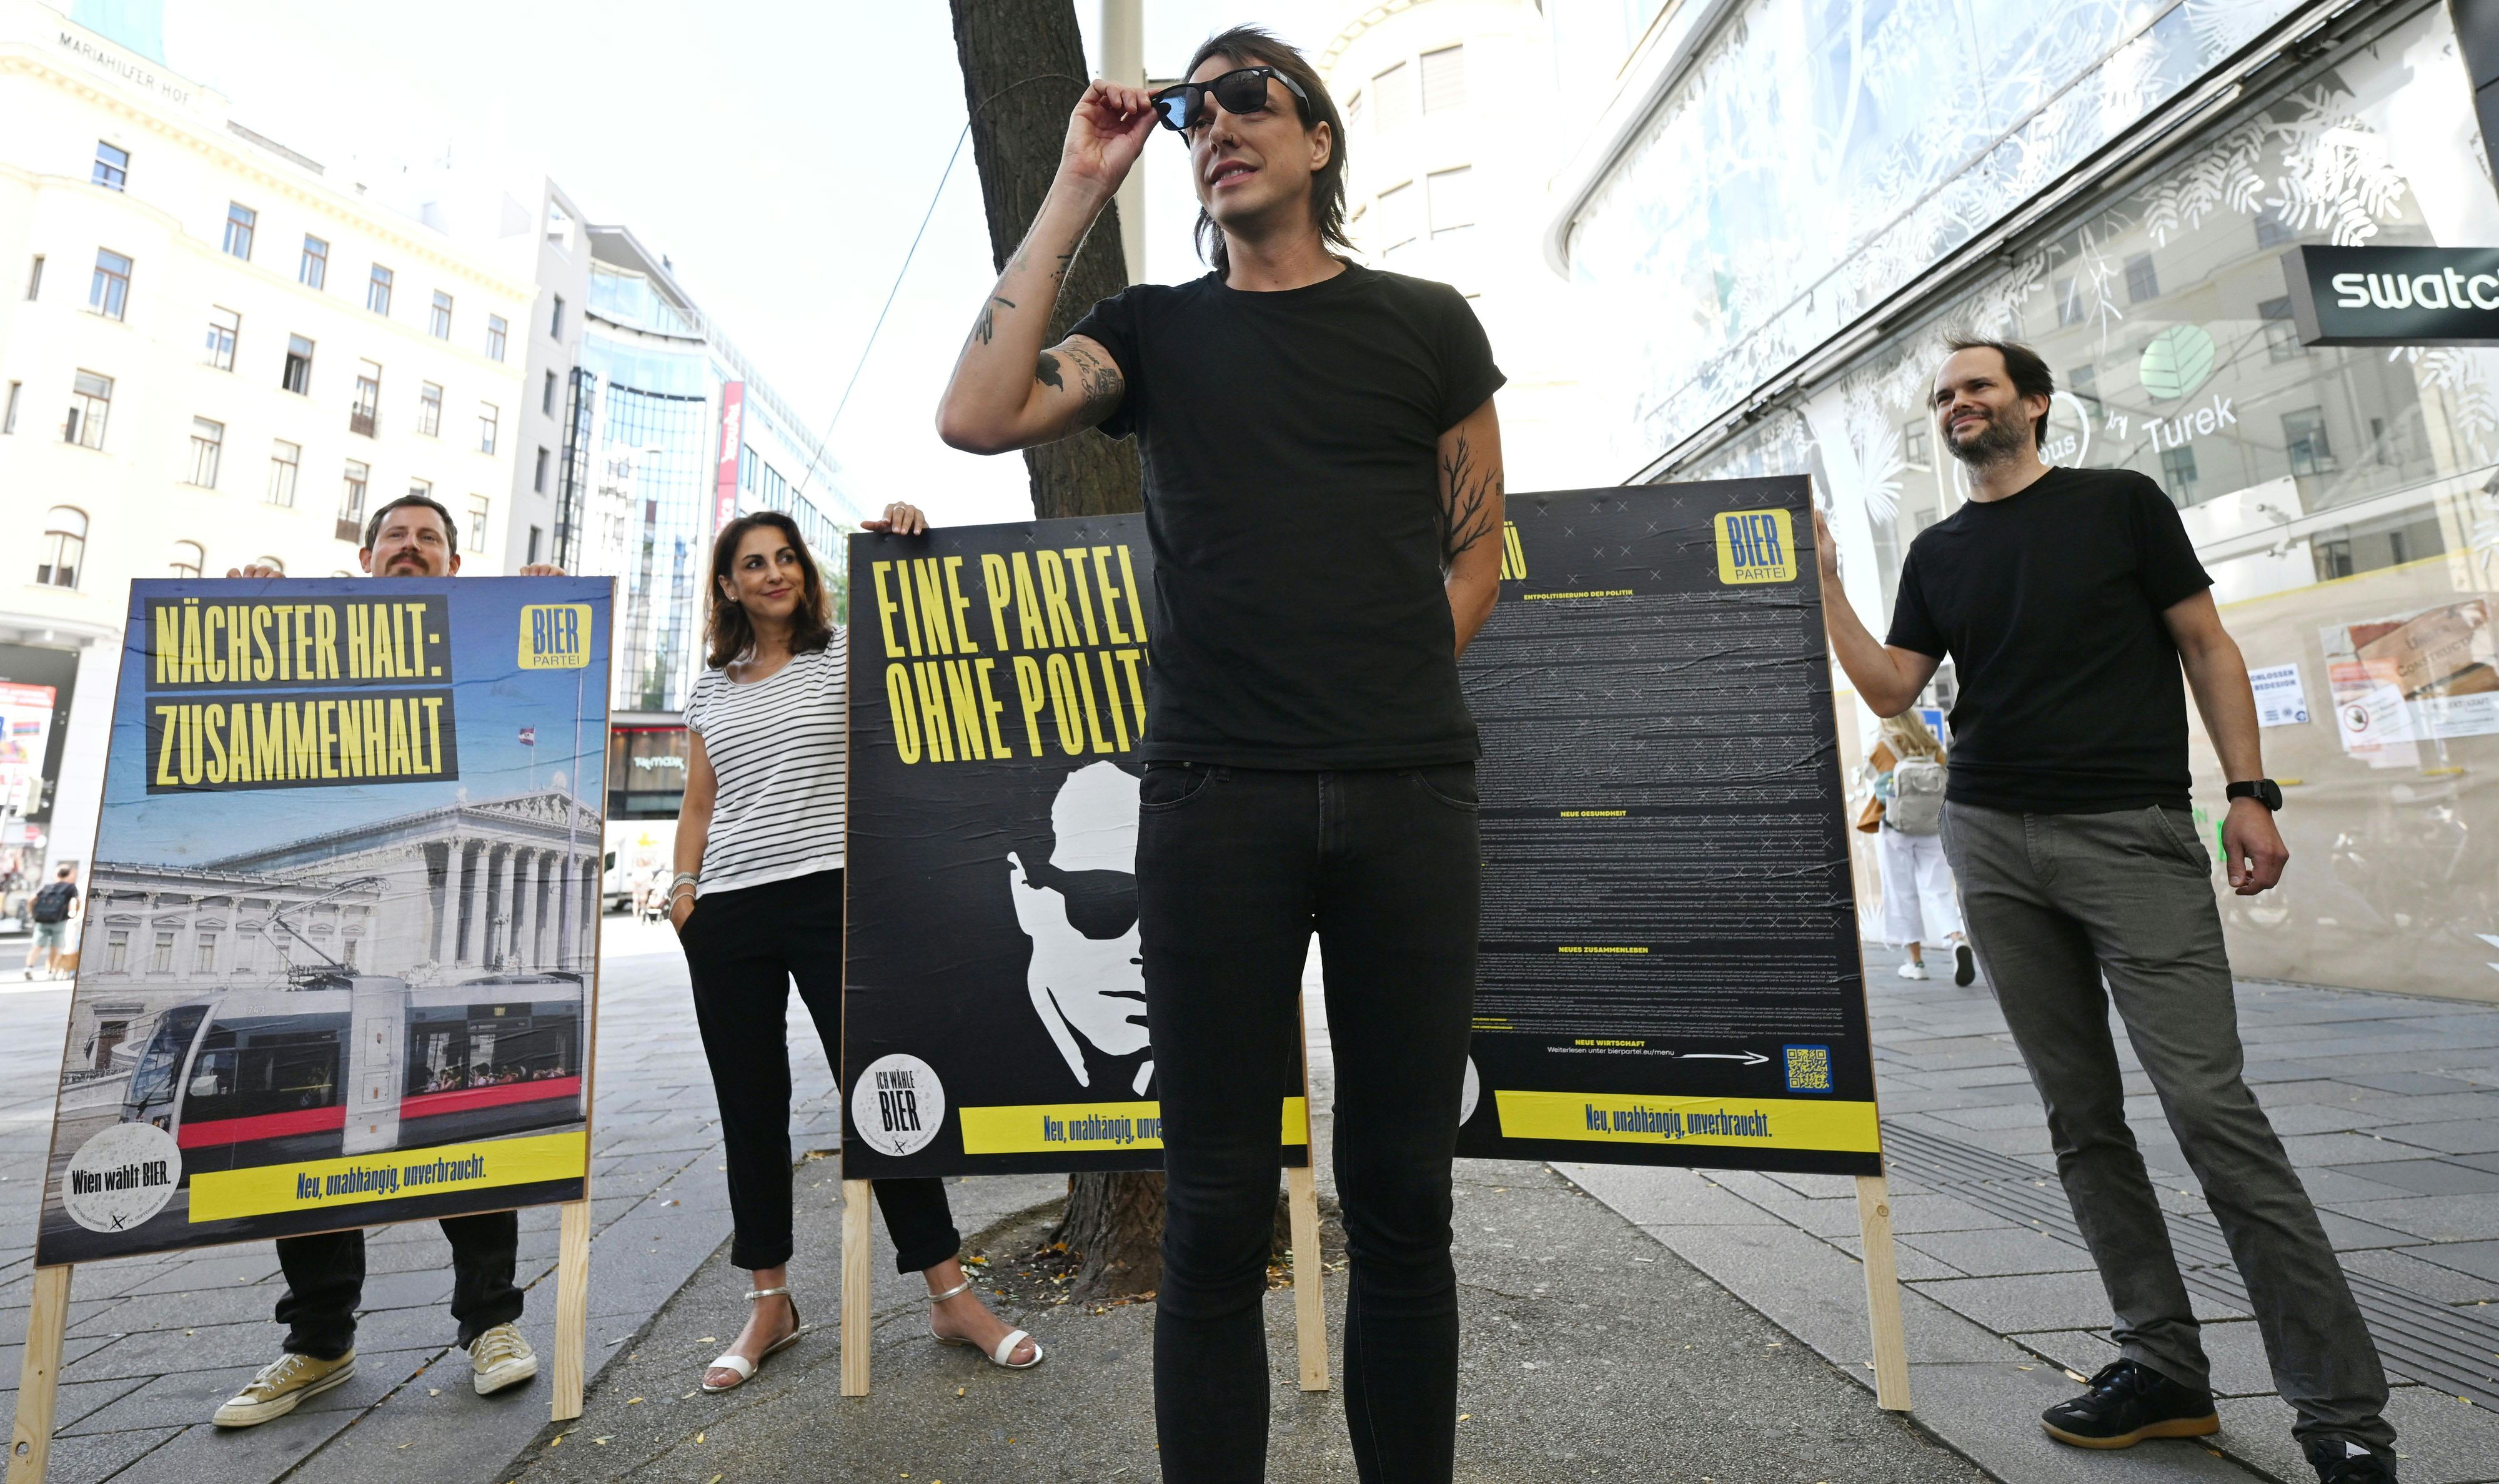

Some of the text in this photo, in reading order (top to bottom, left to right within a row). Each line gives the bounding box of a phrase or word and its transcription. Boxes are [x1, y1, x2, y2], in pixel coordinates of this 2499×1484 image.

[59, 32, 155, 89] MARIAHILFER
[2332, 267, 2499, 310] swatc
[2105, 393, 2237, 454] by Turek
[1726, 514, 1784, 567] BIER
[1736, 567, 1786, 580] PARTEI
[872, 545, 1148, 658] EINE PARTEI
[1523, 591, 1589, 600] ENTPOLITISIERUNG
[156, 598, 442, 683] NÄCHSTER HALT:
[532, 608, 579, 654] BIER
[534, 655, 579, 666] PARTEI
[886, 648, 1150, 764] OHNE POLIT
[155, 697, 444, 786] ZUSAMMENHALT
[1608, 1048, 1675, 1056] bierpartei.eu/menu
[875, 1069, 915, 1090] ICH WÄHLE
[878, 1091, 922, 1132] BIER
[1043, 1115, 1066, 1144] Neu,
[1069, 1114, 1135, 1144] unabhängig,
[1586, 1104, 1772, 1139] Neu, unabhängig, unverbraucht.
[72, 1160, 171, 1195] Wien wählt BIER.
[296, 1153, 487, 1200] Neu, unabhängig, unverbraucht.
[135, 1202, 159, 1222] SEPTEMBER
